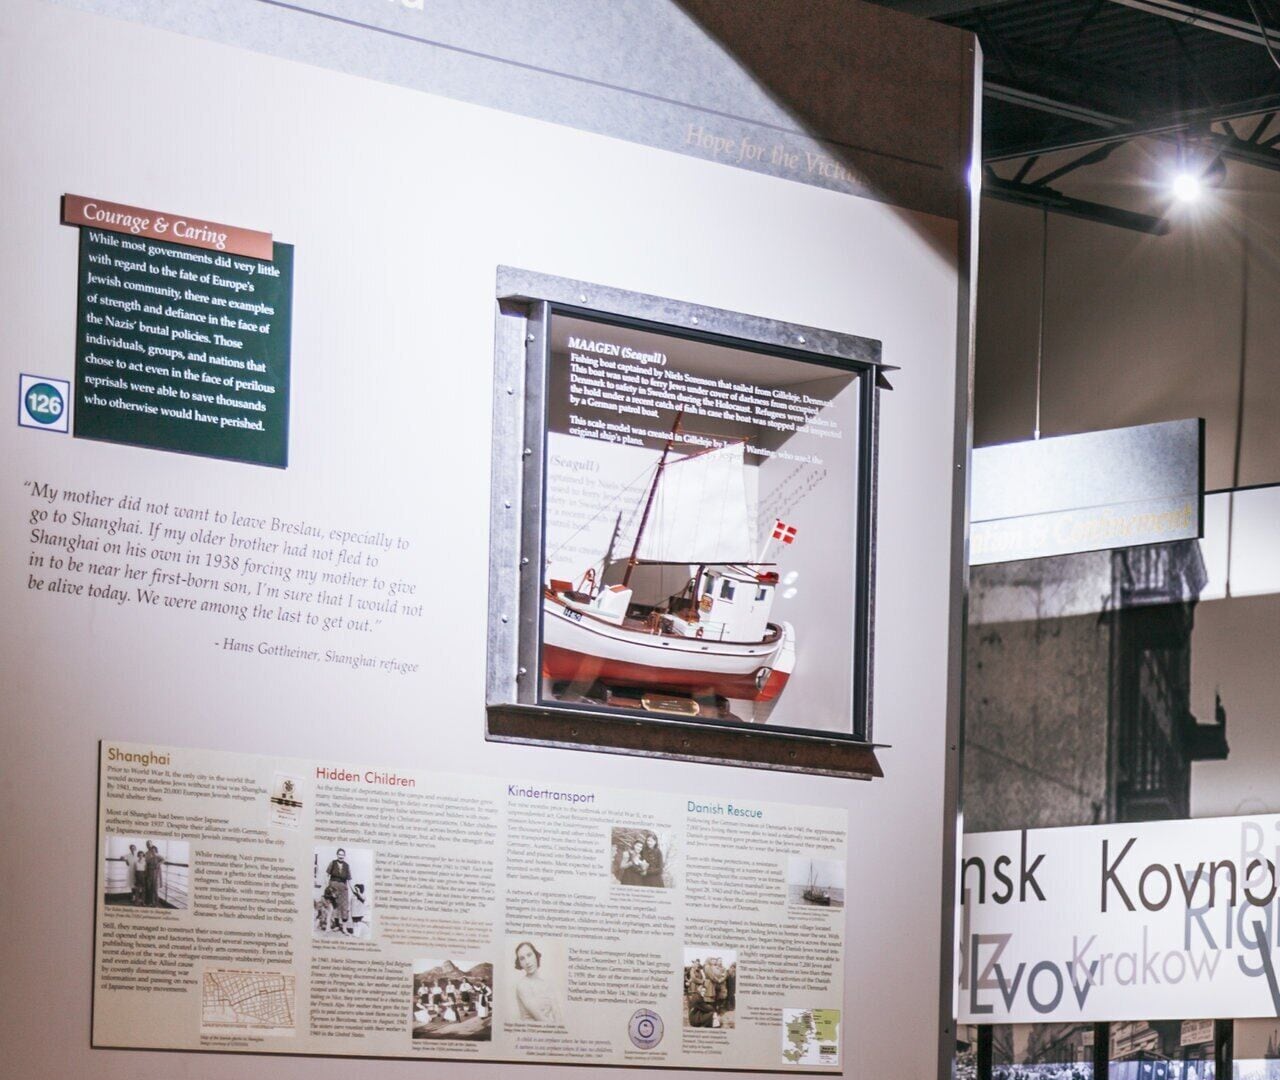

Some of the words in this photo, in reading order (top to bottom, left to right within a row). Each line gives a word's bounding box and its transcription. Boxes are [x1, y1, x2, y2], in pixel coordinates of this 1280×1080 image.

[685, 123, 735, 156] Hope
[736, 135, 767, 163] for
[771, 144, 800, 169] the
[84, 203, 149, 232] Courage
[153, 217, 169, 233] &
[173, 220, 228, 250] Caring
[88, 253, 111, 265] with
[114, 259, 146, 272] regard
[149, 264, 159, 274] to
[161, 265, 177, 278] the
[179, 268, 198, 281] fate
[199, 273, 210, 284] of
[212, 274, 254, 292] Europe's
[89, 231, 119, 246] While
[121, 240, 146, 251] most
[147, 245, 213, 264] governments
[214, 255, 231, 268] did
[233, 261, 255, 275] very
[257, 263, 280, 277] little
[86, 293, 98, 303] of
[99, 296, 141, 312] strength
[143, 304, 162, 315] and
[164, 306, 206, 322] defiance
[208, 313, 218, 325] in
[220, 315, 236, 328] the
[237, 318, 258, 332] face
[258, 323, 270, 334] of
[87, 271, 121, 287] Jewish
[123, 281, 182, 300] community,
[184, 289, 209, 303] there
[211, 297, 227, 306] are
[228, 300, 274, 315] examples
[567, 337, 620, 356] MAAGEN
[621, 347, 667, 365] (Seagull)
[29, 392, 62, 415] 126
[24, 480, 57, 503] “My
[63, 490, 114, 506] mother
[118, 495, 141, 511] did
[146, 502, 168, 515] not
[174, 506, 209, 521] want
[214, 510, 227, 523] to
[231, 511, 266, 529] leave
[271, 517, 324, 538] Breslau,
[329, 530, 392, 551] especially
[397, 537, 409, 549] to
[29, 509, 48, 524] go
[53, 509, 66, 523] to
[72, 512, 142, 535] Shanghai.
[149, 522, 159, 541] If
[164, 528, 186, 544] my
[190, 528, 225, 545] older
[229, 533, 278, 552] brother
[283, 540, 307, 557] had
[312, 549, 332, 560] not
[338, 549, 361, 564] fled
[366, 555, 378, 566] to
[107, 747, 171, 767] Shanghai
[315, 766, 360, 783] Hidden
[364, 771, 416, 788] Children
[507, 784, 595, 805] Kindertransport
[687, 800, 724, 816] Danish
[727, 804, 763, 819] Rescue
[1101, 837, 1278, 913] Kovno
[970, 933, 1100, 1015] Lvov
[1071, 924, 1222, 987] Krakow
